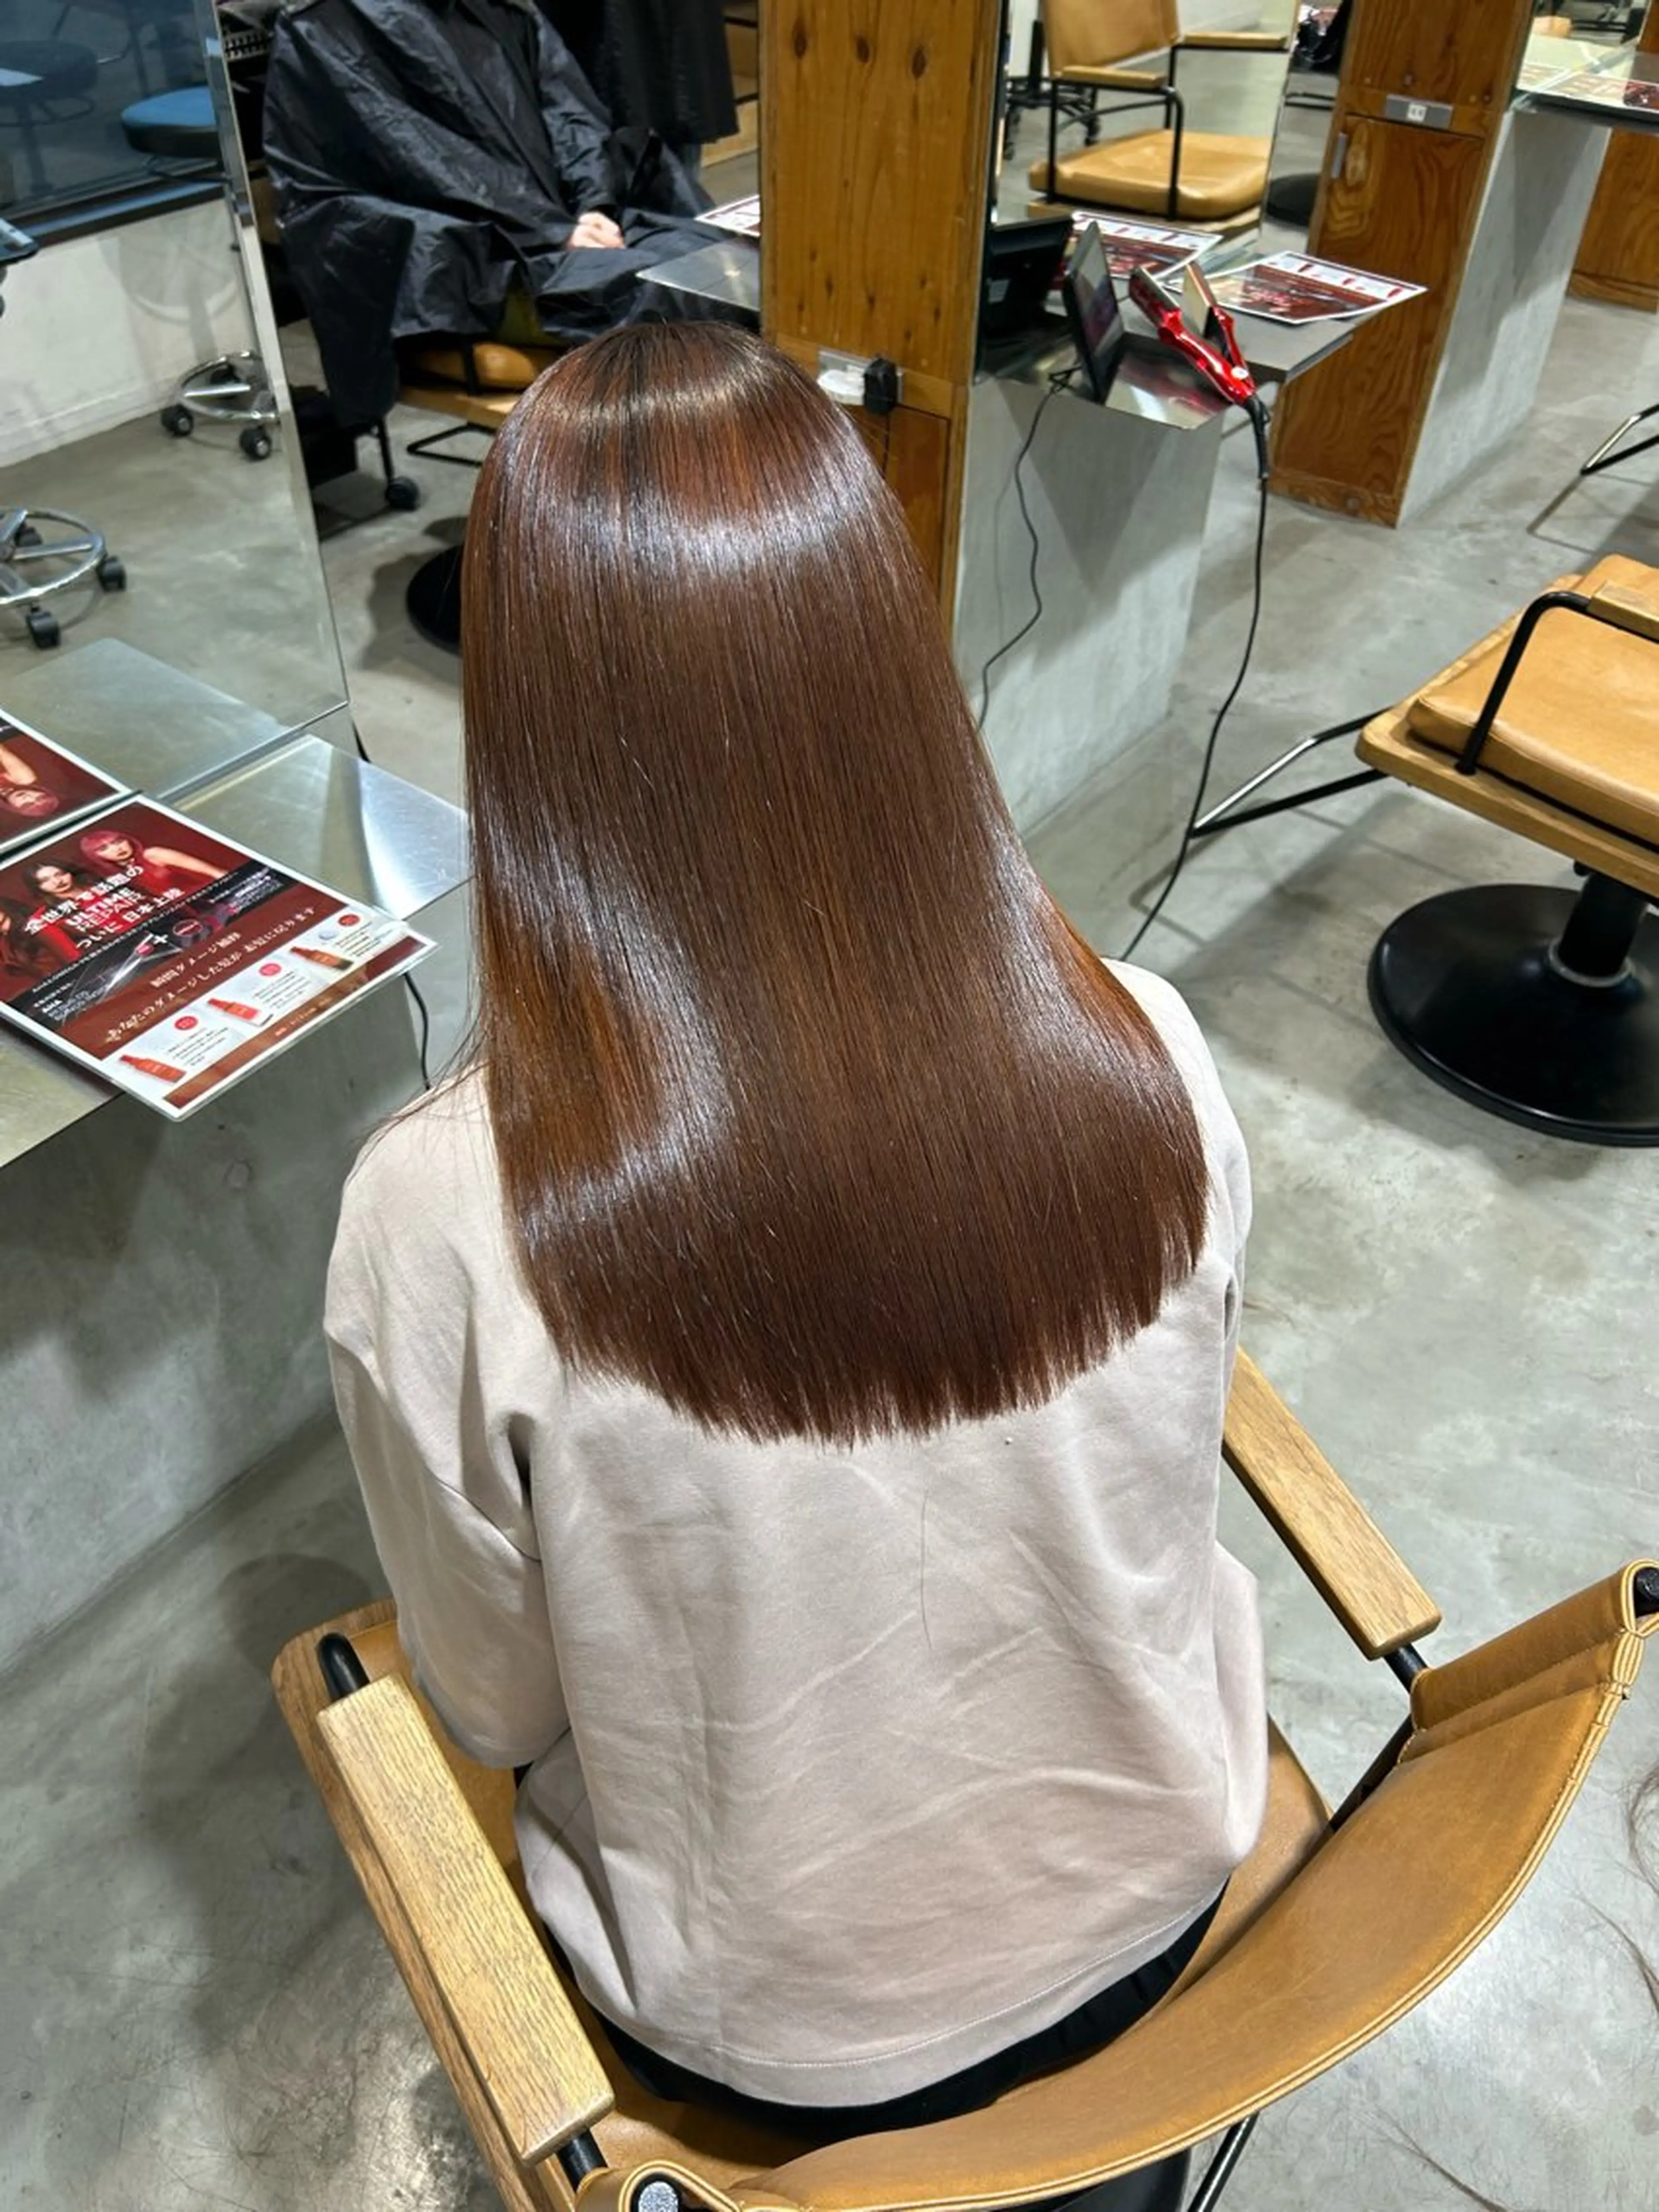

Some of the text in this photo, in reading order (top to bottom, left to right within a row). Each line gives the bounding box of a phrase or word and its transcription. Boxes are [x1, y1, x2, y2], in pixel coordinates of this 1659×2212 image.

[74, 890, 146, 932] REPAIR
[122, 887, 185, 922] 日本上陸
